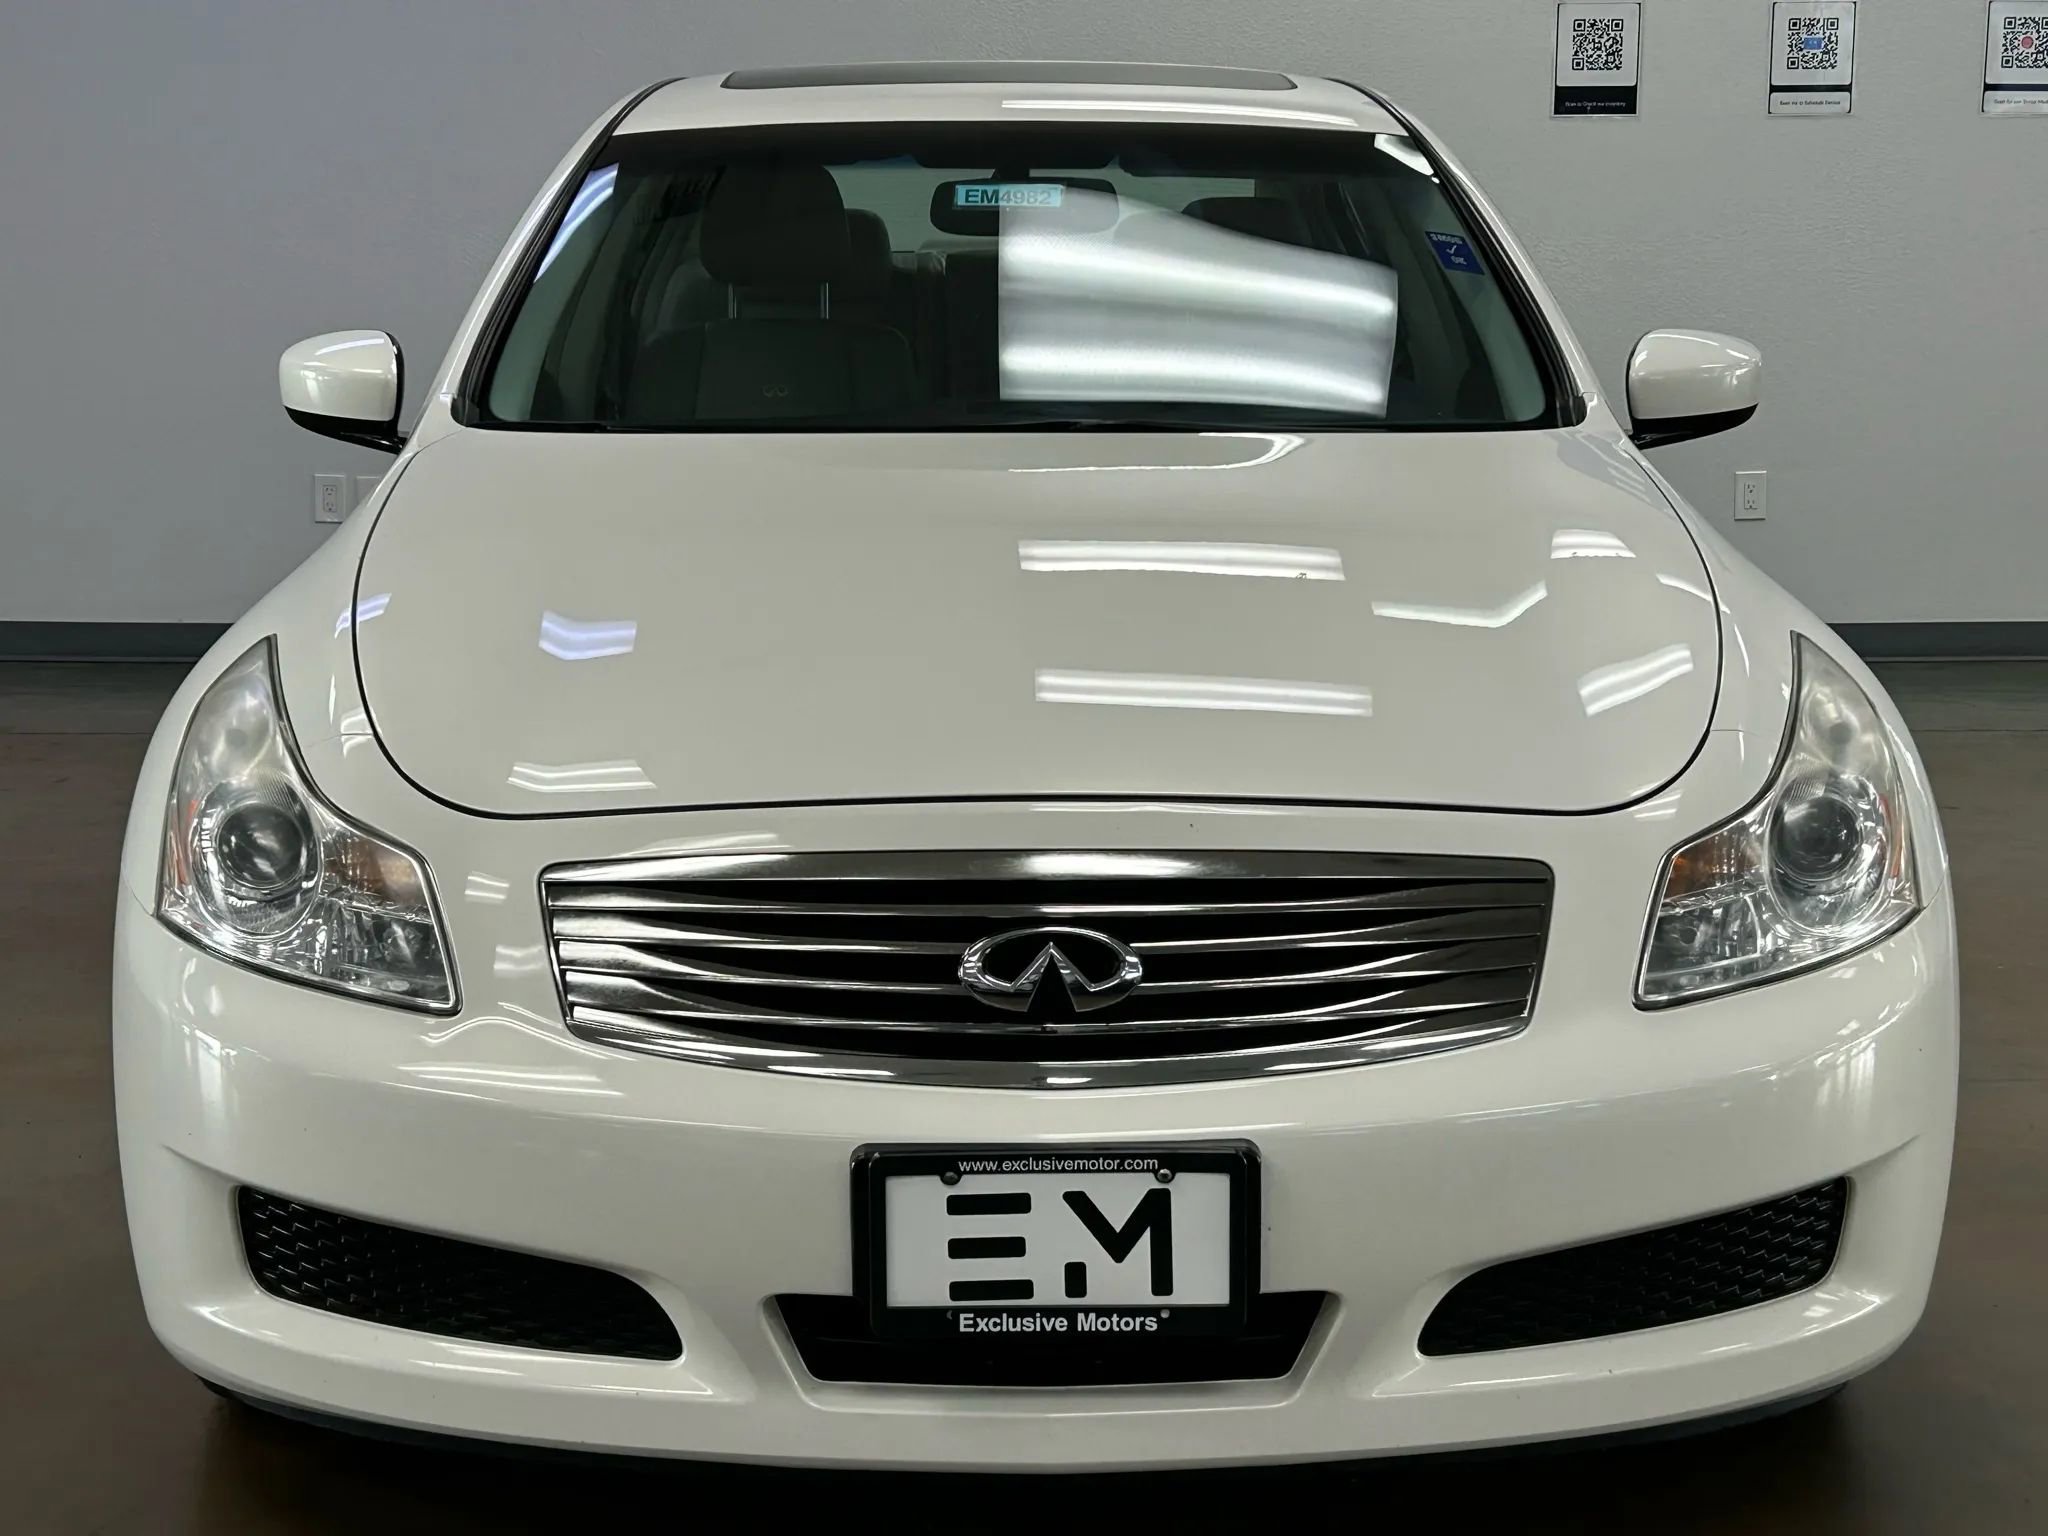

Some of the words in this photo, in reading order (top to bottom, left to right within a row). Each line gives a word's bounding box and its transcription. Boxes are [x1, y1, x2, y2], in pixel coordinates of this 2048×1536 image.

[965, 188, 1052, 205] EM4982
[958, 1157, 1158, 1172] www.exclusivemotor.com
[959, 1312, 1068, 1333] Exclusive
[1077, 1312, 1158, 1332] Motors
